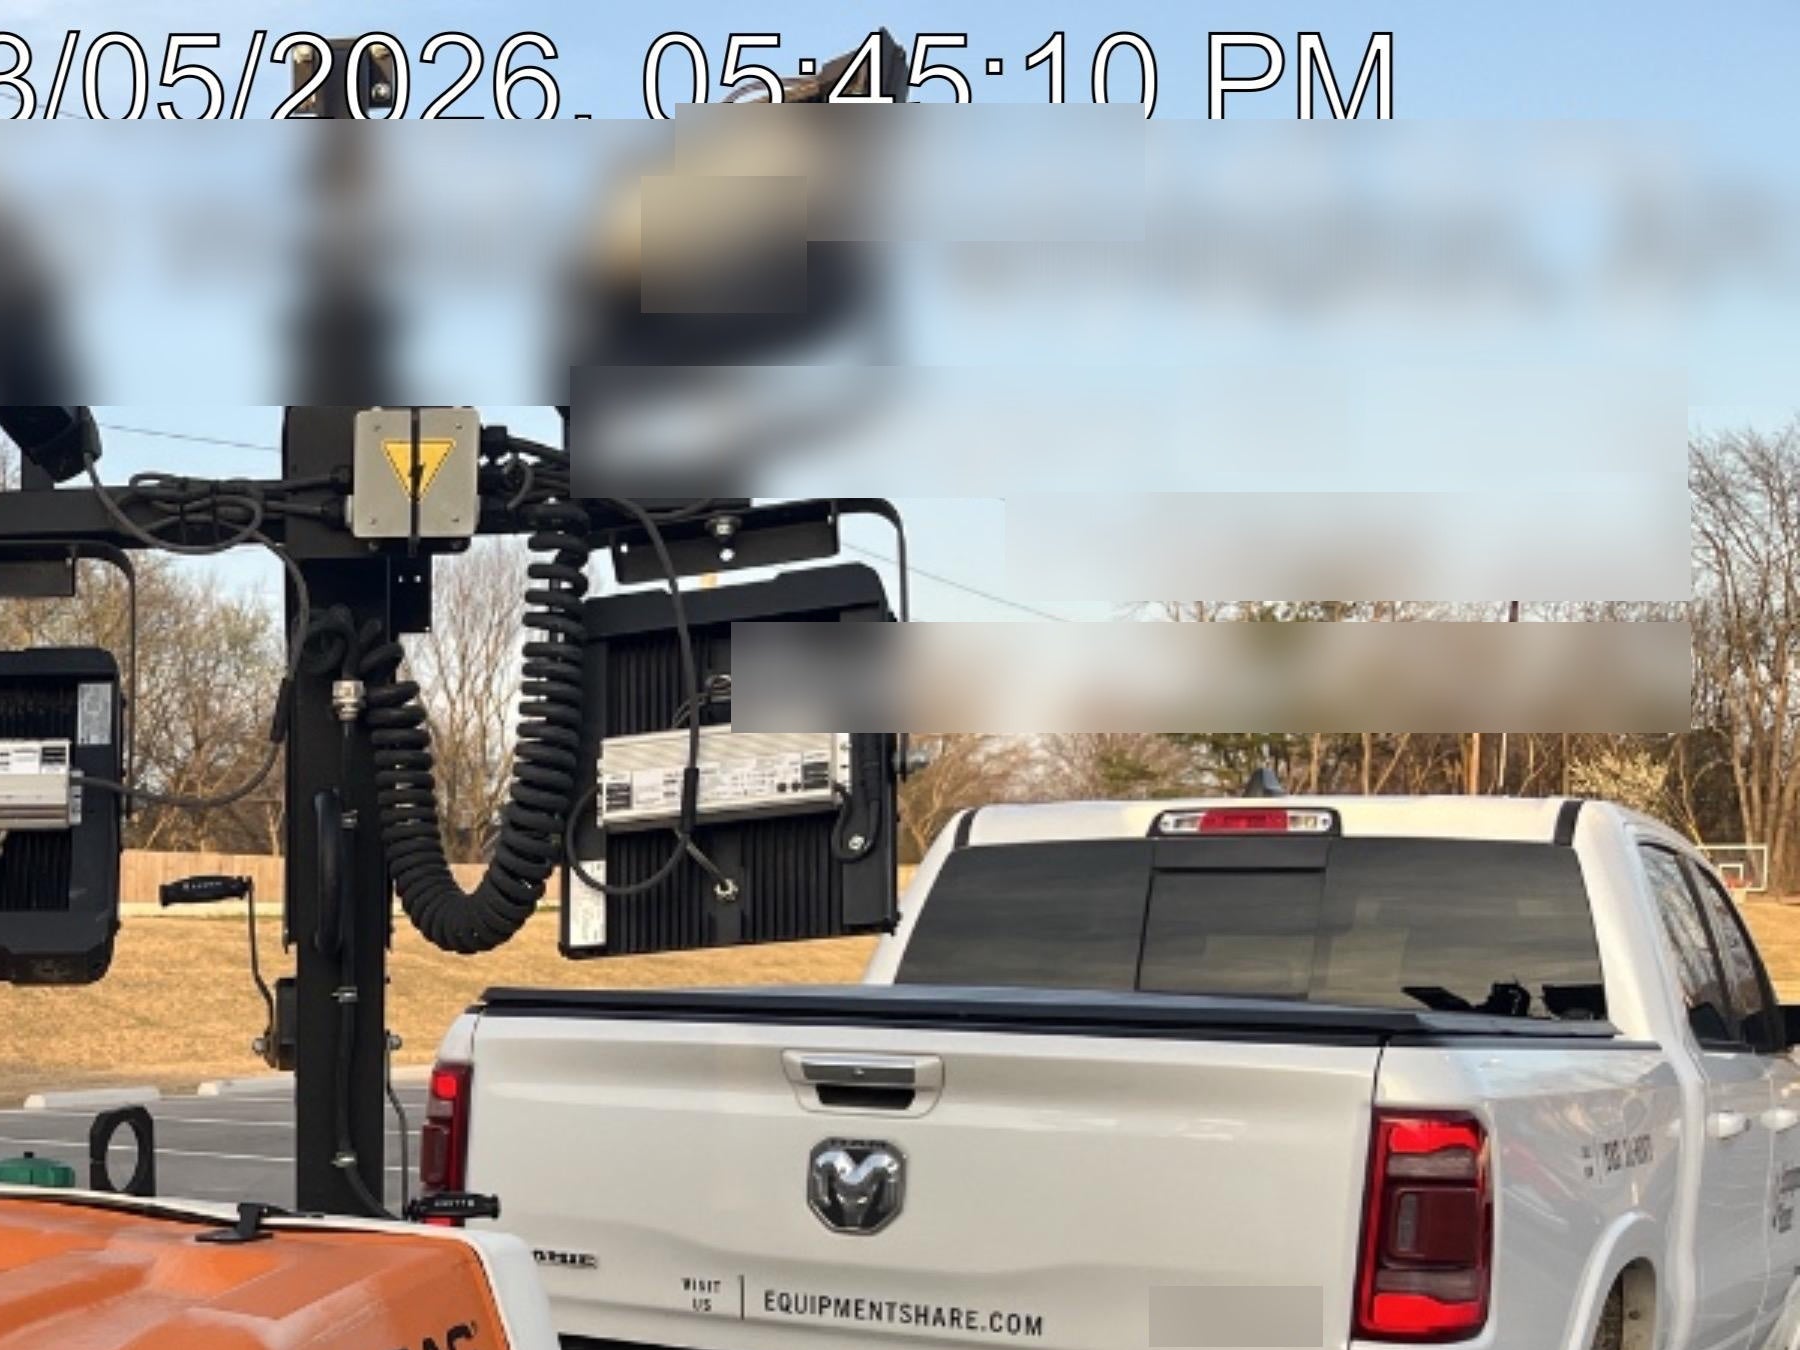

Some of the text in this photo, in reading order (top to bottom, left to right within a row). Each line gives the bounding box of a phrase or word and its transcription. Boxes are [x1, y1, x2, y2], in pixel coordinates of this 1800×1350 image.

[681, 1277, 721, 1294] VISIT
[692, 1298, 713, 1313] US
[763, 1288, 1044, 1337] EQUIPMENTSHARE.COM
